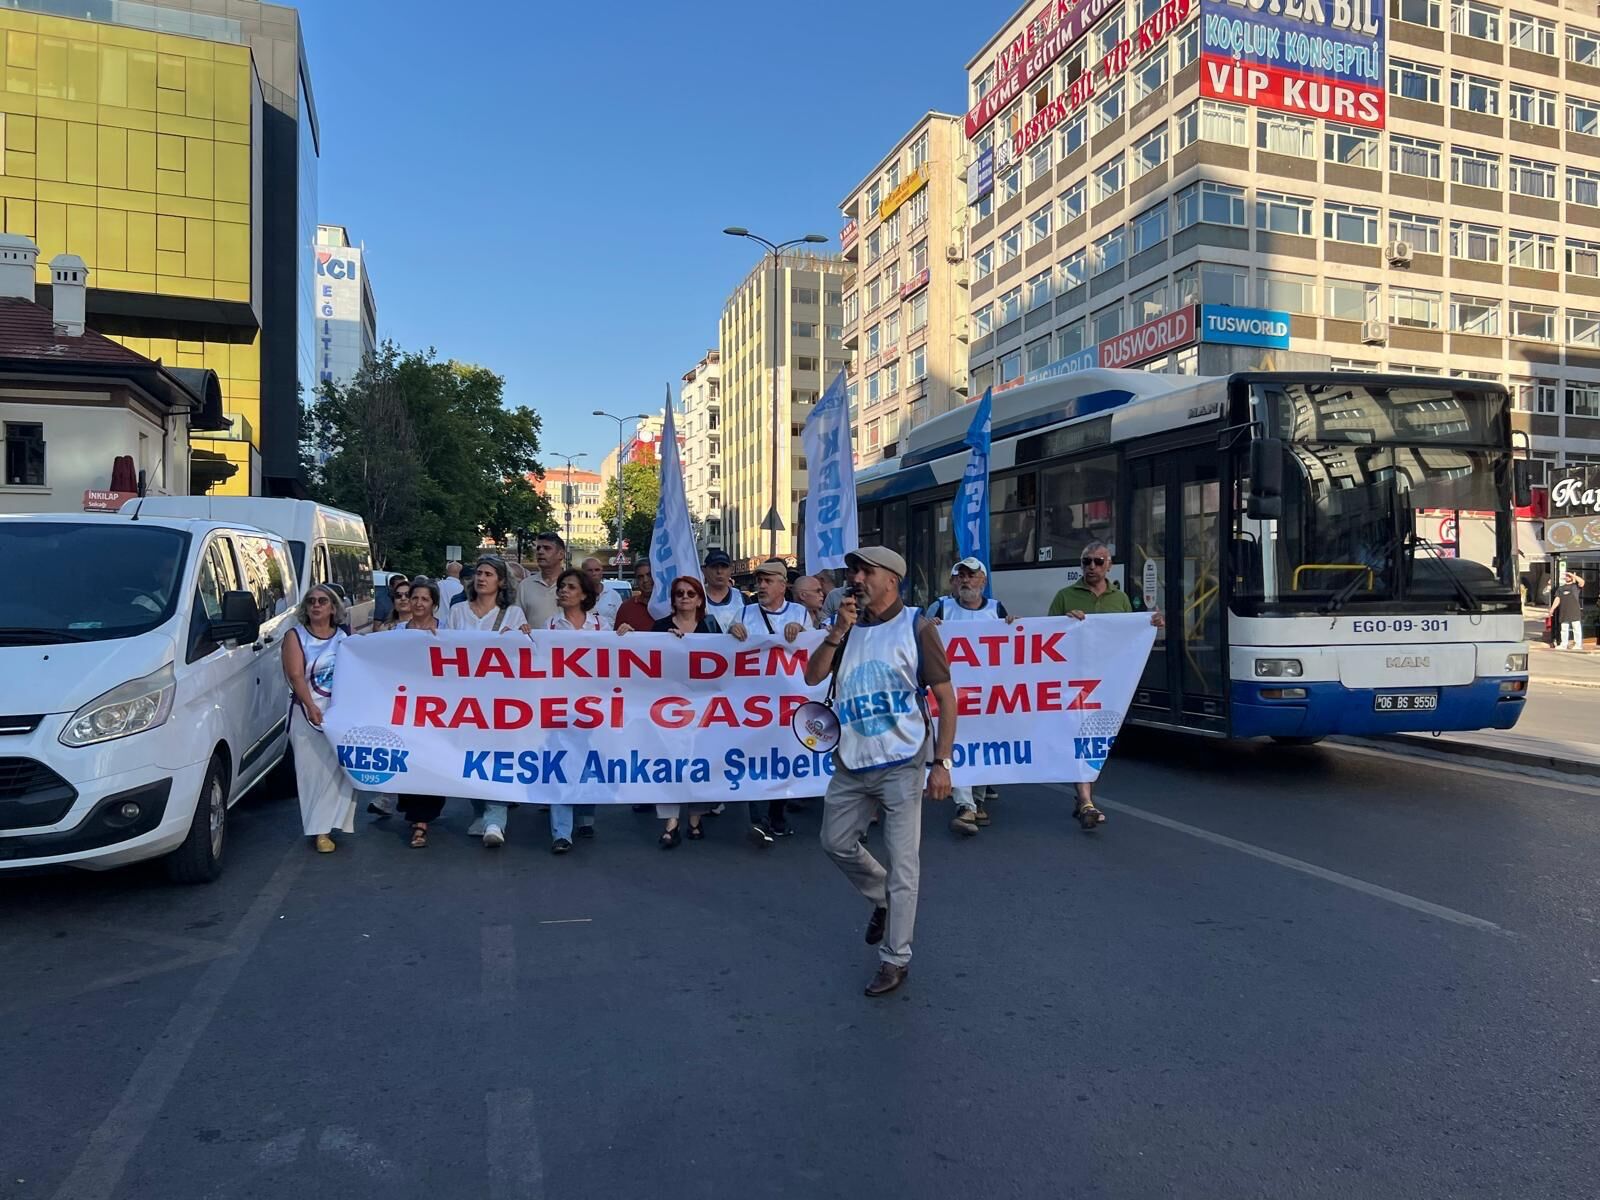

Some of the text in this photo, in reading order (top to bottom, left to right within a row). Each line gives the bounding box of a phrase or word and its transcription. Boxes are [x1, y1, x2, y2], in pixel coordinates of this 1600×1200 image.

[1205, 14, 1379, 80] KOÇLUK KONSEPTLİ
[985, 73, 1020, 118] İVME
[1026, 22, 1073, 80] EĞİTİM
[1011, 94, 1068, 156] DESTEK
[1070, 68, 1096, 109] BİL
[1103, 38, 1131, 82] VİP
[1138, 0, 1190, 54] KURS
[1207, 61, 1379, 122] VİP KURS
[1103, 314, 1188, 369] DUSWORLD
[1207, 314, 1288, 337] TUSWORLD
[88, 491, 119, 500] İNKILAP
[429, 646, 662, 679] HALKIN
[1386, 656, 1430, 669] MAN
[390, 685, 623, 729] İRADESİ
[839, 690, 912, 725] KESK
[1381, 696, 1435, 708] 06 BS 9550
[337, 745, 409, 773] KESK
[462, 750, 568, 784] KESK
[589, 750, 710, 784] Ankara
[723, 747, 834, 791] Şubele
[361, 773, 380, 783] 1995
